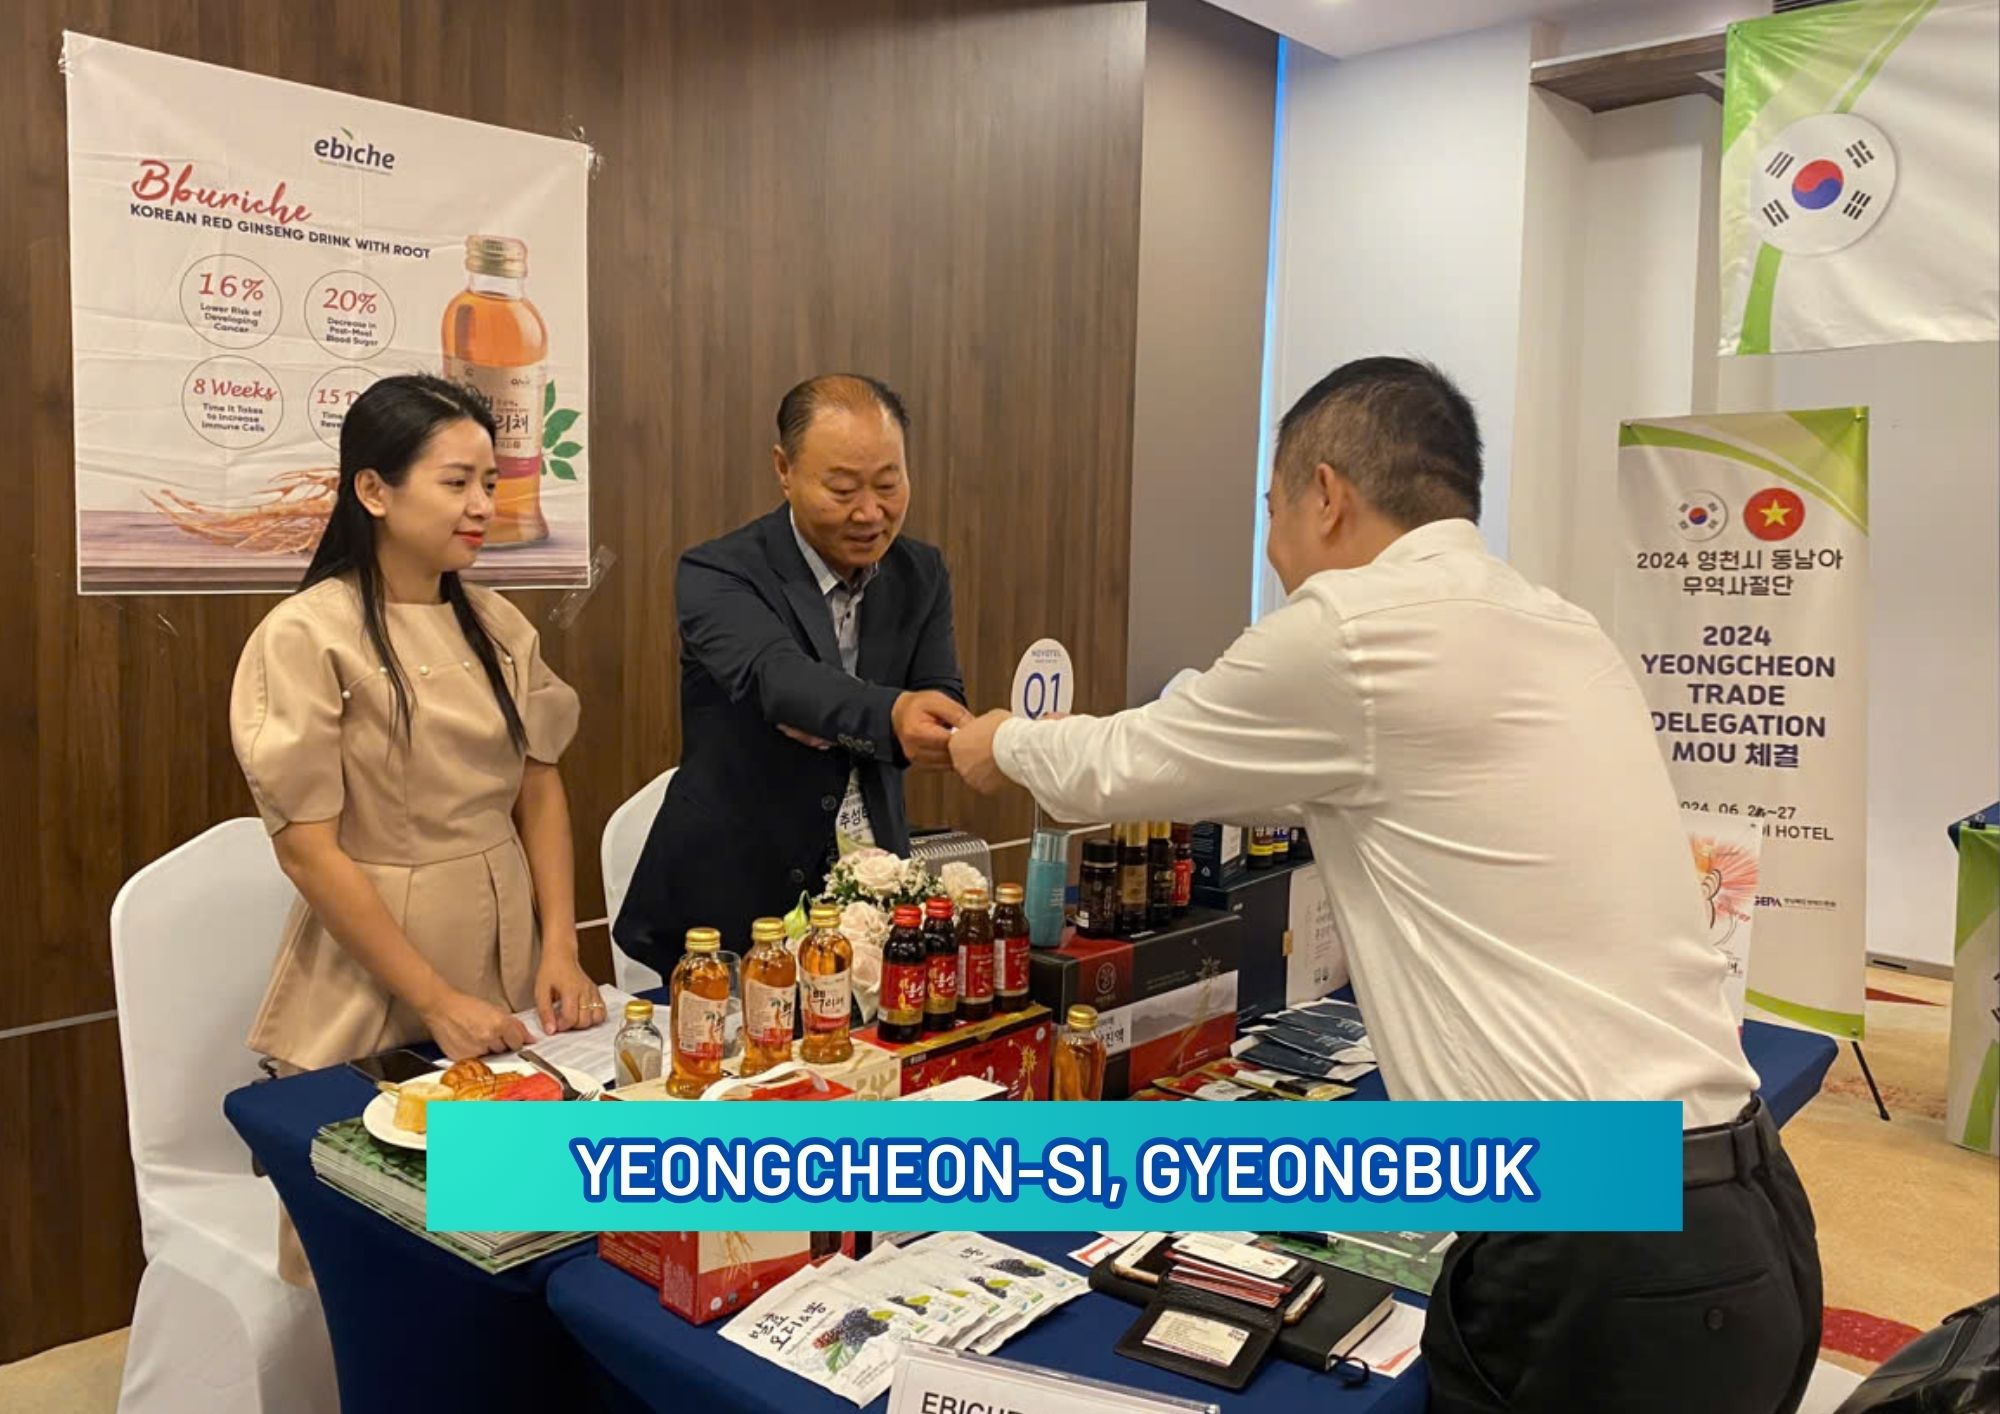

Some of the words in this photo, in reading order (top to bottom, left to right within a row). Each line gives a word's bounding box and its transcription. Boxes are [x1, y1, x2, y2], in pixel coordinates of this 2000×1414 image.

[314, 133, 395, 169] ebiche
[132, 160, 312, 224] Bburiche
[130, 203, 197, 225] KOREAN
[202, 214, 232, 229] RED
[237, 219, 304, 241] GINSENG
[308, 231, 350, 248] DRINK
[355, 237, 390, 254] WITH
[393, 243, 430, 259] ROOT
[199, 273, 264, 301] 16%
[200, 302, 228, 313] Lower
[231, 306, 250, 315] Risk
[252, 309, 262, 317] of
[323, 288, 377, 314] 20%
[205, 312, 259, 327] Developing
[214, 322, 249, 333] Cancer
[327, 317, 366, 329] Decrease
[326, 335, 350, 344] Blood
[353, 337, 378, 347] Sugar
[193, 379, 205, 395] 8
[211, 379, 277, 401] Weeks
[317, 389, 340, 404] 15
[203, 403, 225, 412] Time
[237, 406, 264, 415] Takes
[207, 413, 215, 421] to
[218, 414, 260, 423] Increase
[201, 421, 239, 431] Immune
[242, 423, 265, 432] Cells
[1637, 552, 1689, 569] 2024
[1698, 550, 1762, 571] 영천시
[1771, 548, 1843, 571] 동남아
[1682, 575, 1795, 597] 무역사절단
[1703, 625, 1771, 648] 2024
[1641, 653, 1836, 677] YEONGCHEON
[1024, 672, 1060, 719] 01
[1687, 683, 1785, 706] TRADE
[1651, 711, 1826, 738] DELEGATION
[1672, 741, 1736, 764] MOU
[1745, 743, 1799, 769] 체결
[1776, 825, 1834, 841] HOTEL
